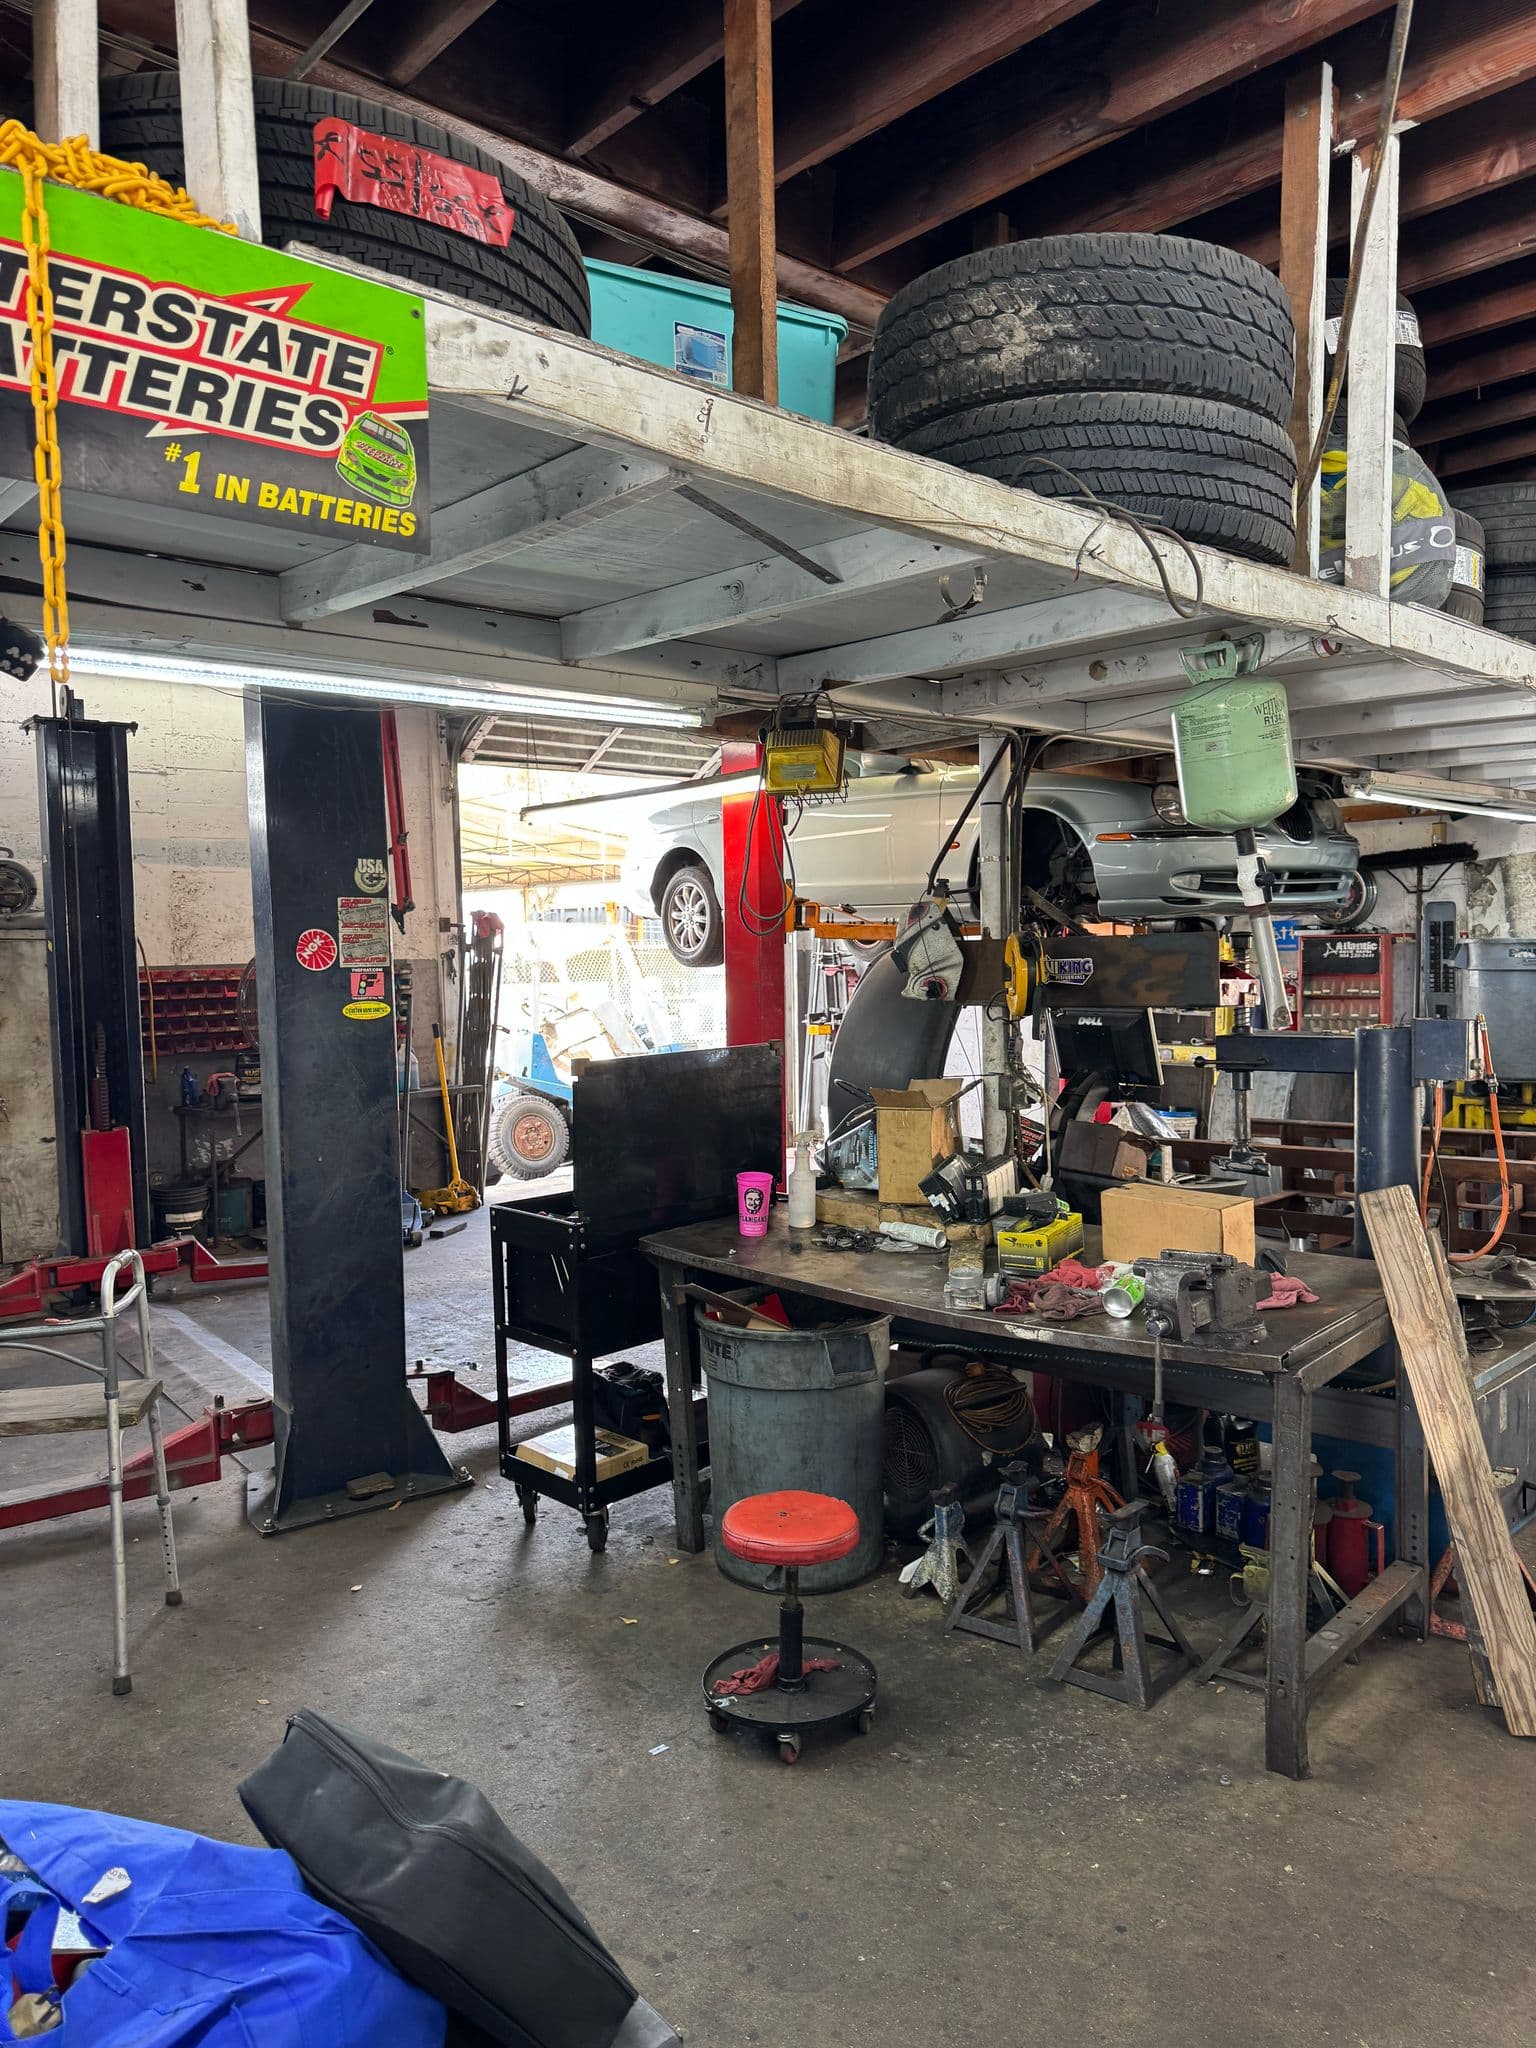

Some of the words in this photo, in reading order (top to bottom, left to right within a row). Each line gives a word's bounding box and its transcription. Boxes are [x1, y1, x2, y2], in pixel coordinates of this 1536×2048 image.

[165, 443, 201, 494] #1
[215, 473, 249, 505] IN
[258, 482, 417, 537] BATTERIES
[1264, 713, 1285, 725] R134
[357, 858, 385, 874] USA
[301, 935, 325, 959] NGK
[1077, 1017, 1102, 1026] DELL
